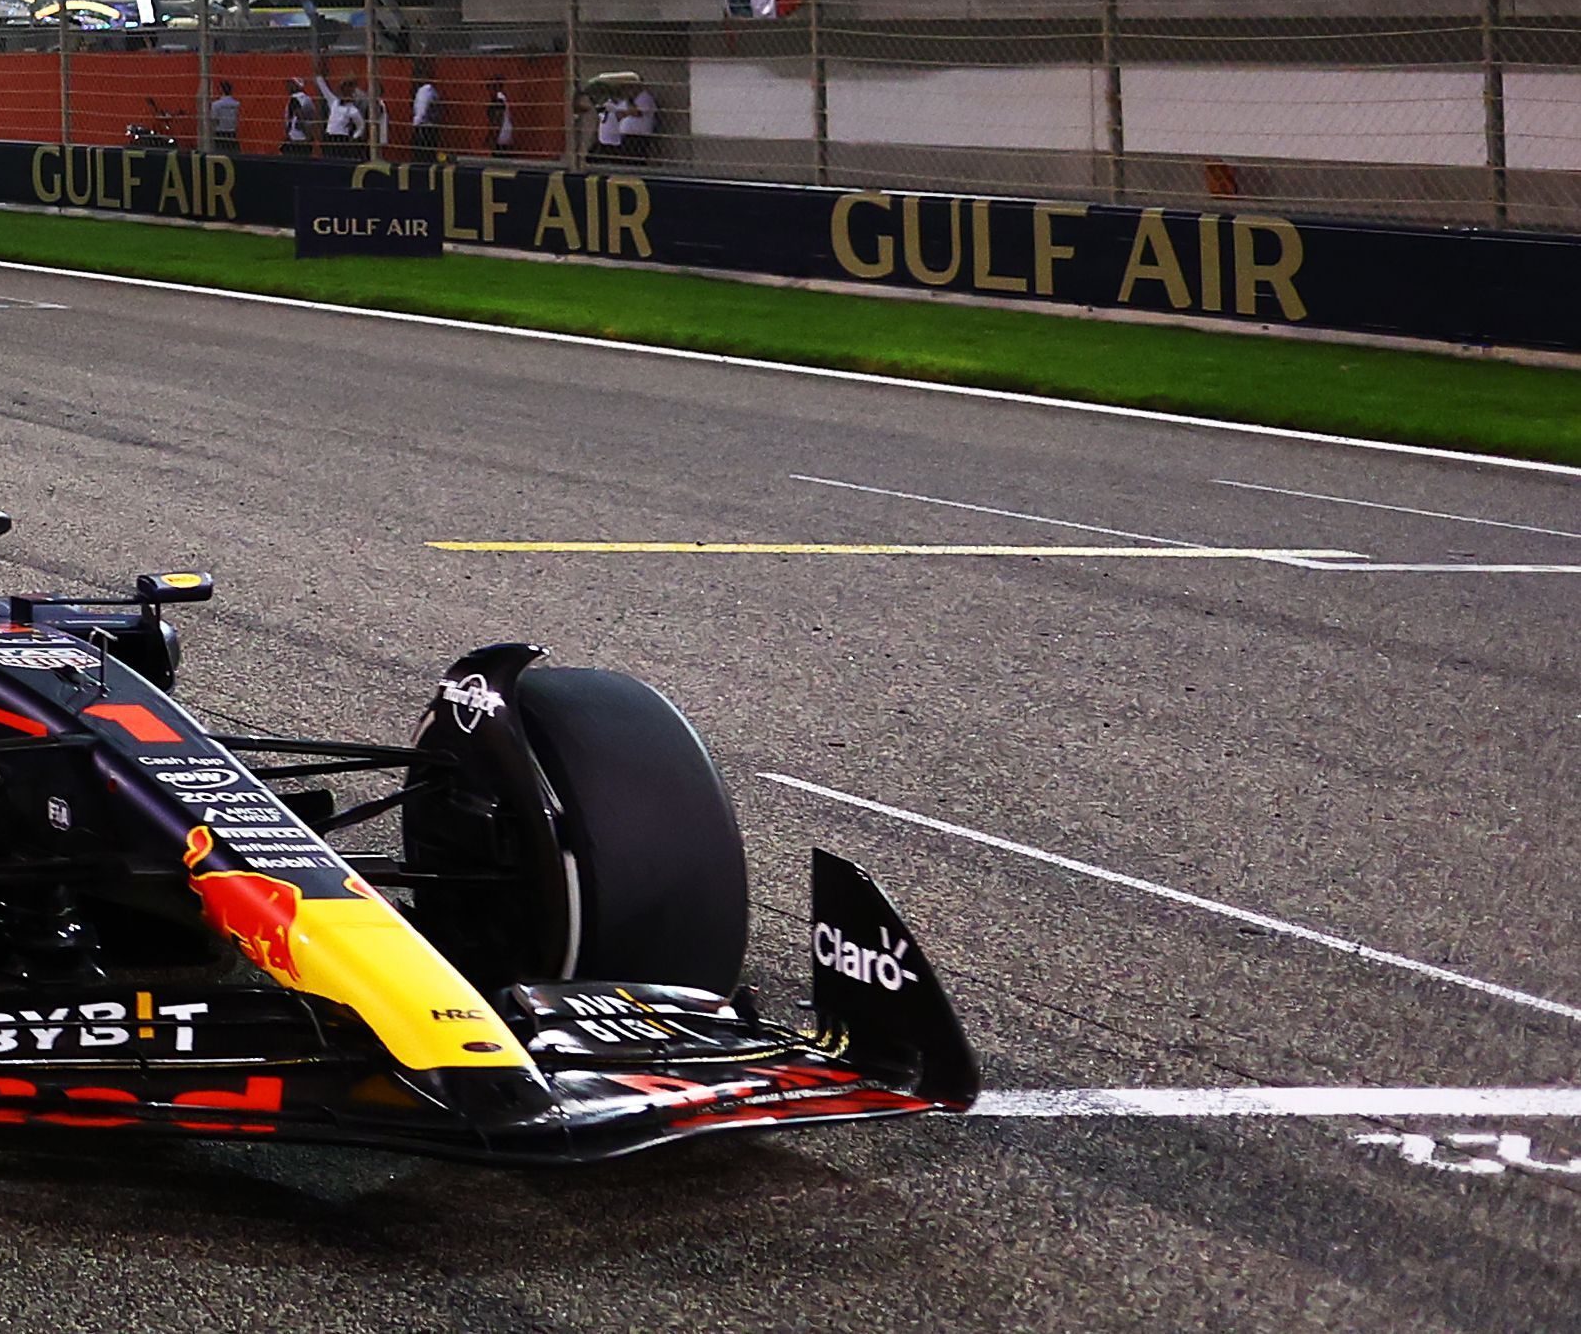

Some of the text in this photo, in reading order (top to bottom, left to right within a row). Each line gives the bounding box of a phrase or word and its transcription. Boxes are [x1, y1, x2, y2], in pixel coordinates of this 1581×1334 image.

[31, 144, 237, 220] GULF AIR
[312, 216, 429, 237] GULF AIR
[535, 170, 652, 258] AIR
[831, 189, 1307, 322] GULF AIR
[81, 703, 185, 743] 1
[138, 756, 225, 766] Cash App
[174, 791, 269, 803] zoom
[244, 856, 317, 868] Mobil
[814, 922, 904, 991] Claro
